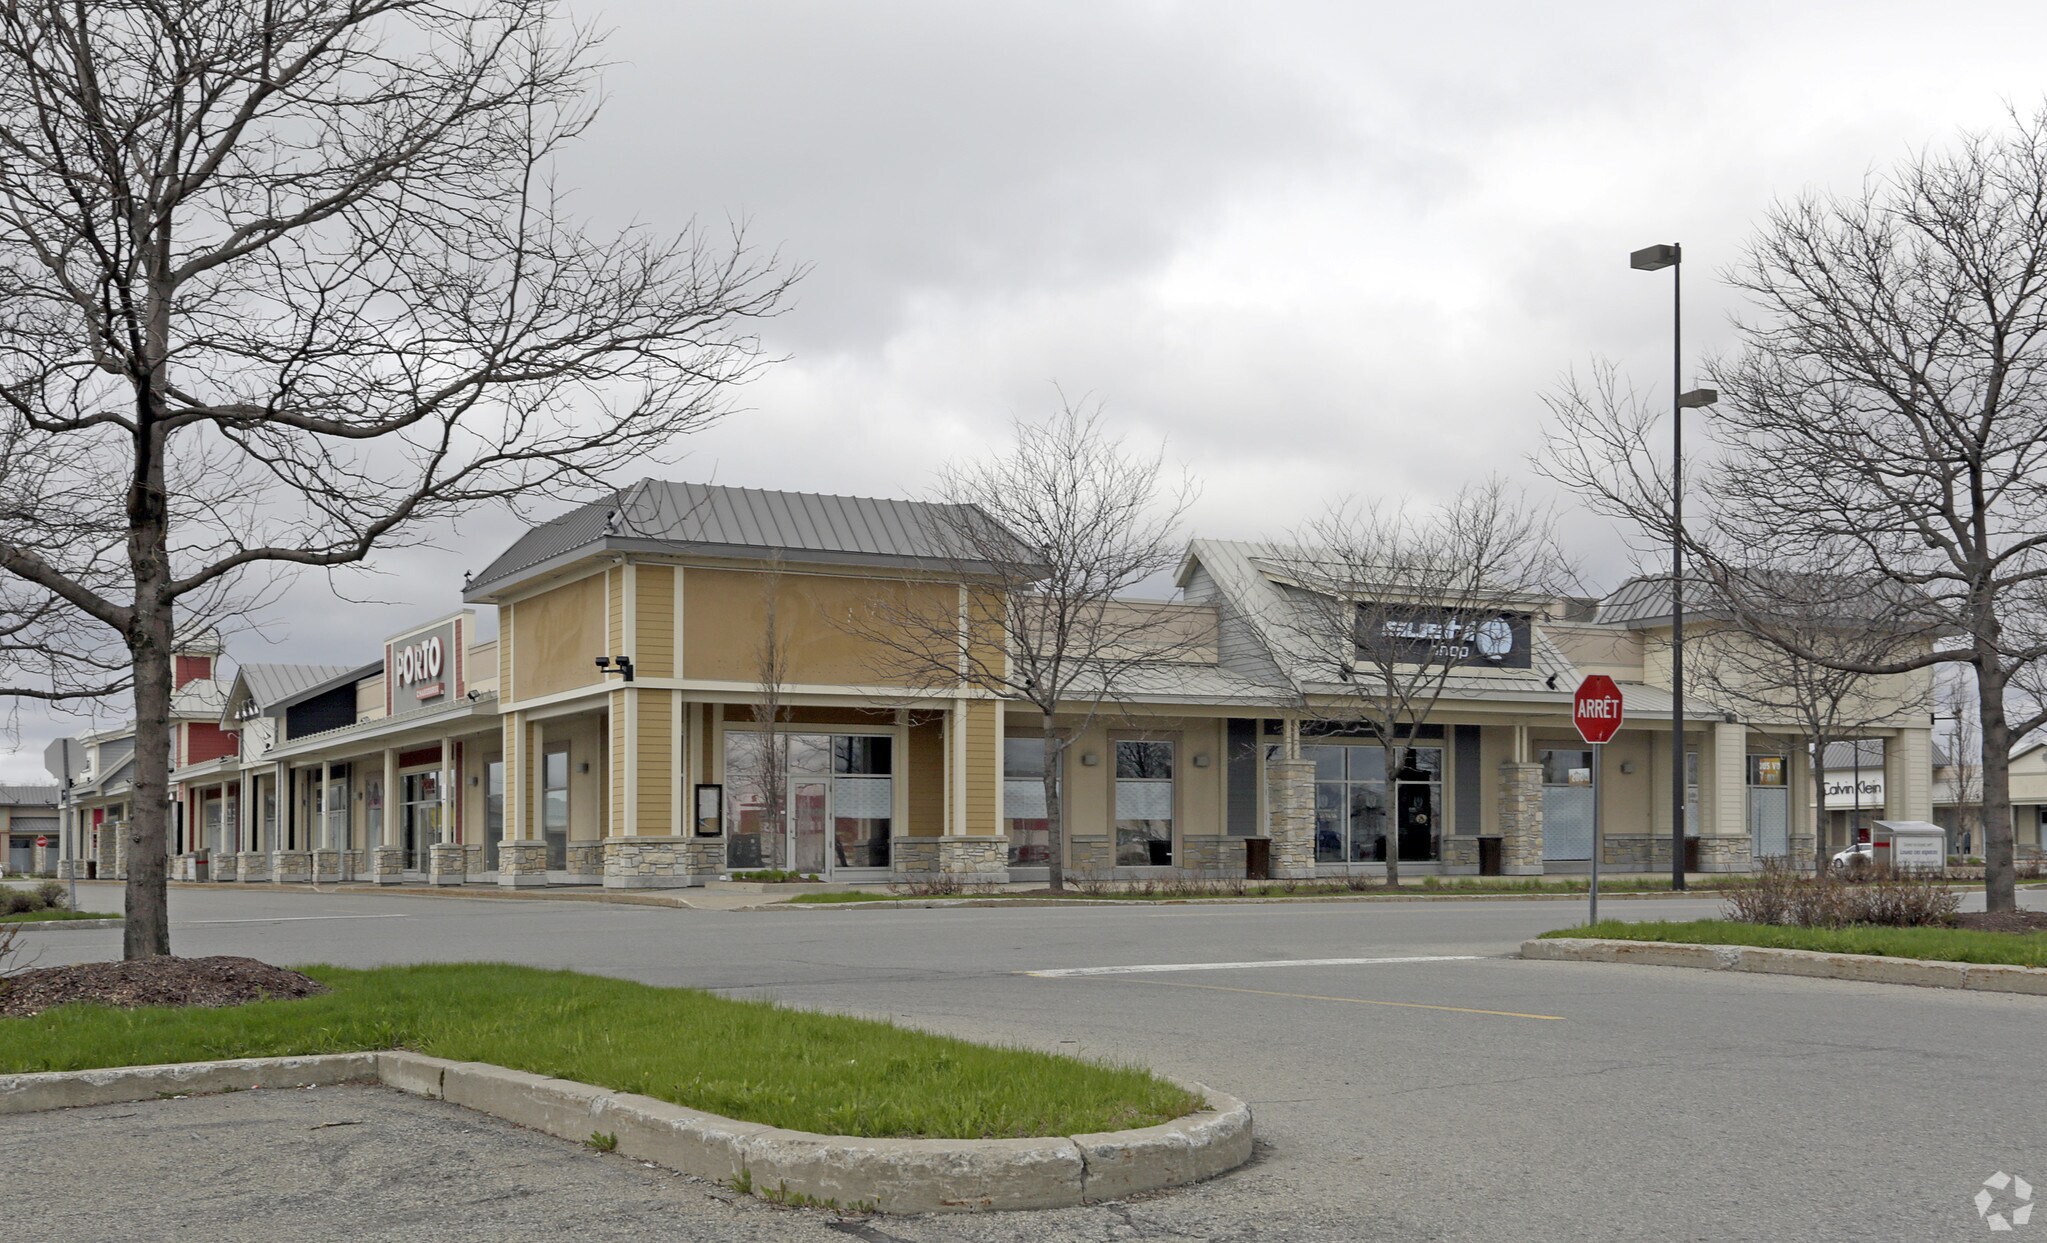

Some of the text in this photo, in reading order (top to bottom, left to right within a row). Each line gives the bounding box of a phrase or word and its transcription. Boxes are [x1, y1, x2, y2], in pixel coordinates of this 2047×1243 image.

[396, 636, 443, 687] PORTO
[1577, 694, 1620, 719] ARRÊT
[1822, 780, 1882, 796] Calvin Klein
